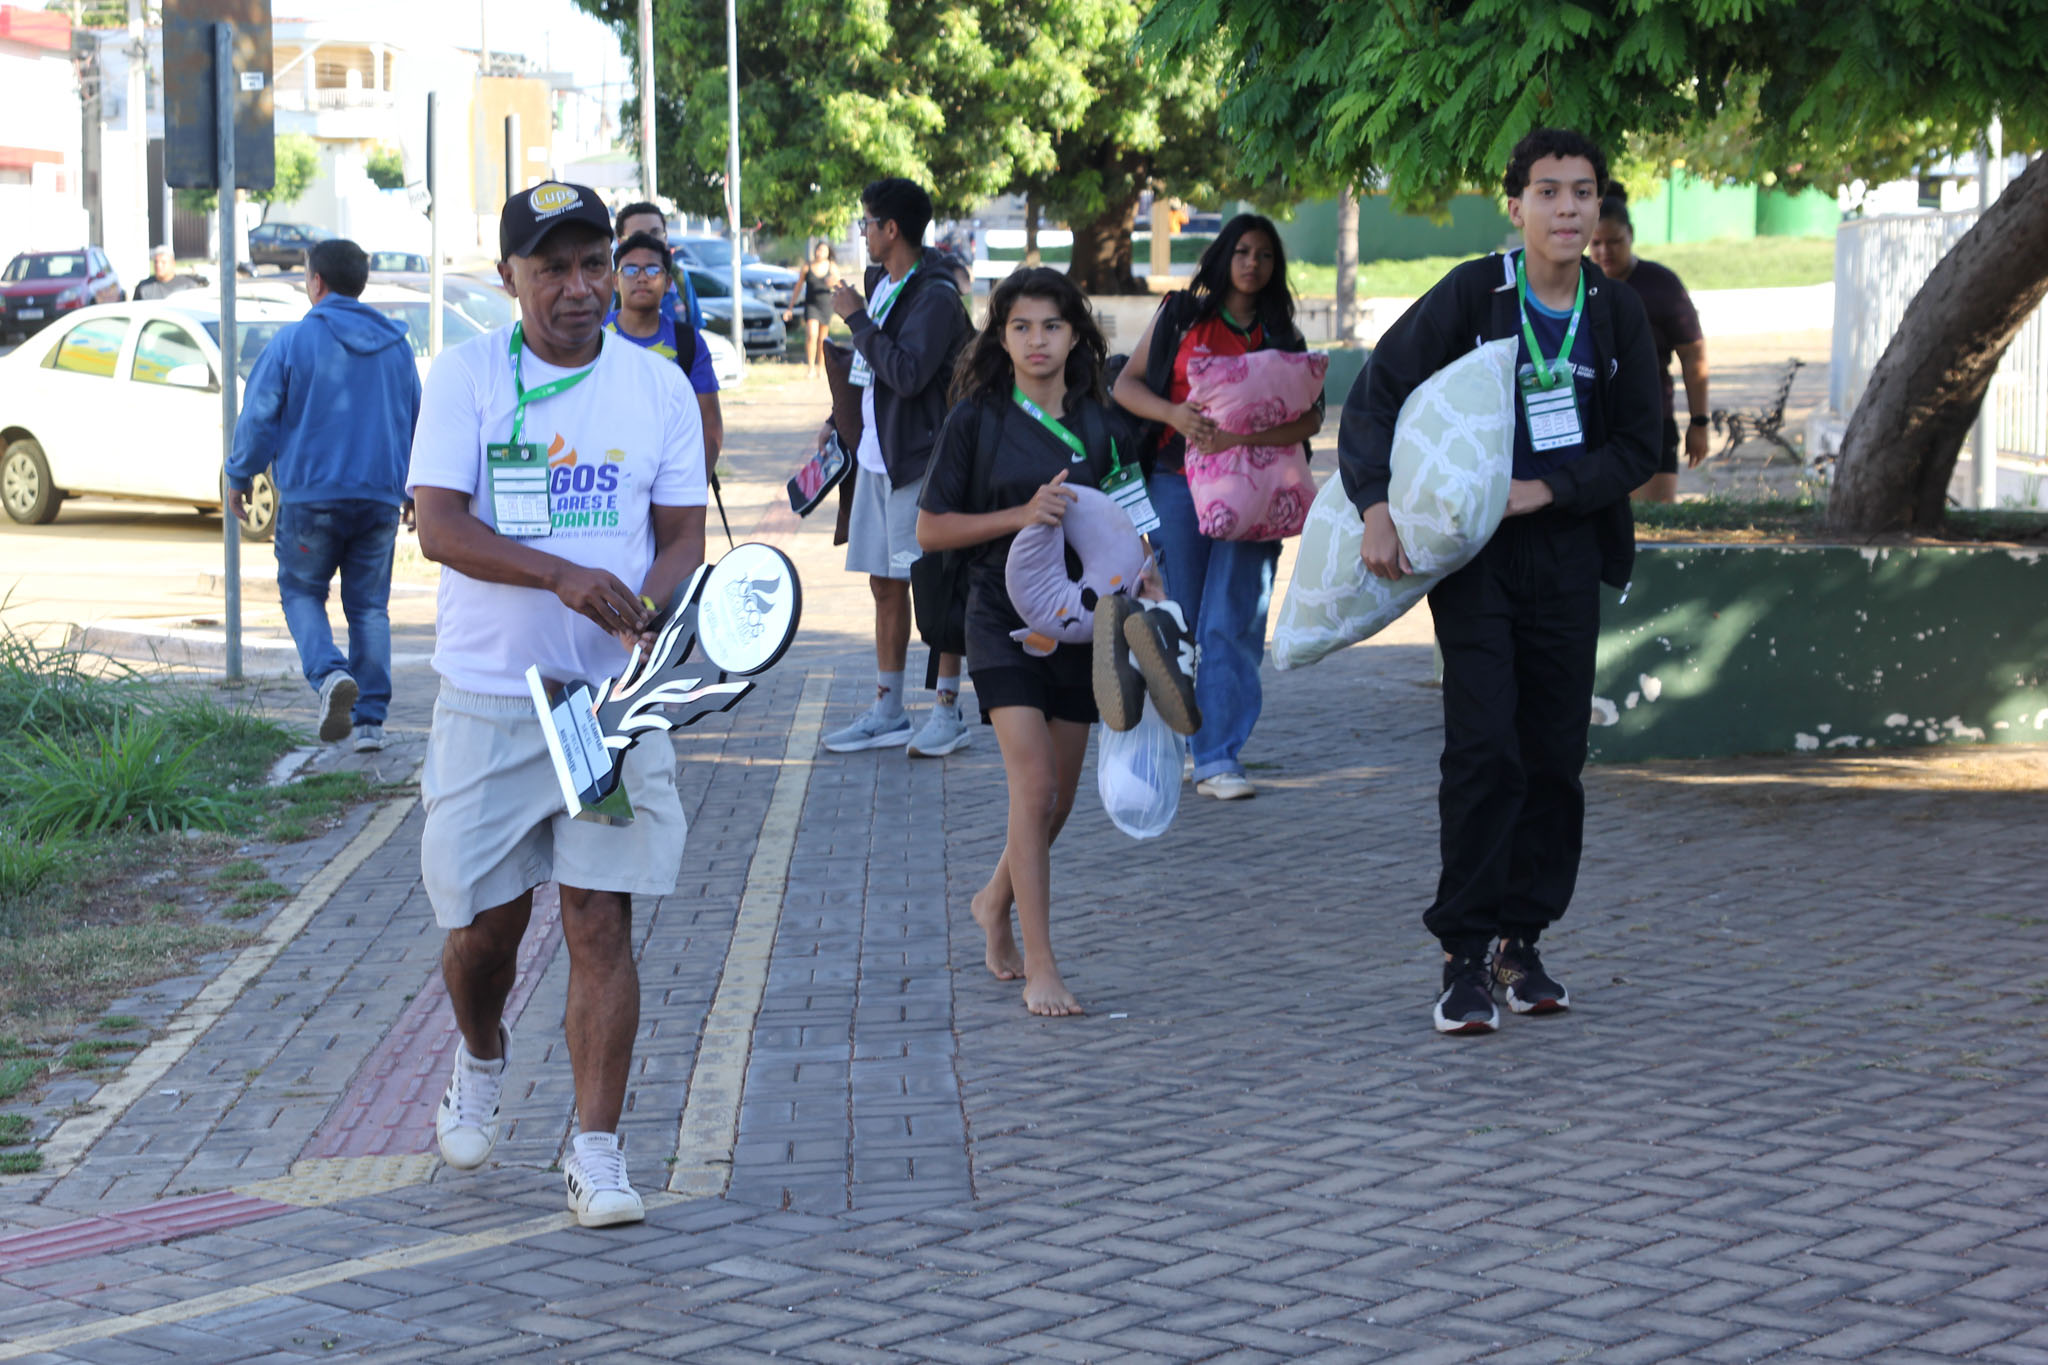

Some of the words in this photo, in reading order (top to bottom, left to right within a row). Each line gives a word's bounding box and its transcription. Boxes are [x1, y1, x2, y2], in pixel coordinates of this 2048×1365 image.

[535, 190, 577, 205] Lups
[549, 464, 619, 494] GOS
[606, 495, 617, 509] E
[551, 511, 619, 528] DANTIS
